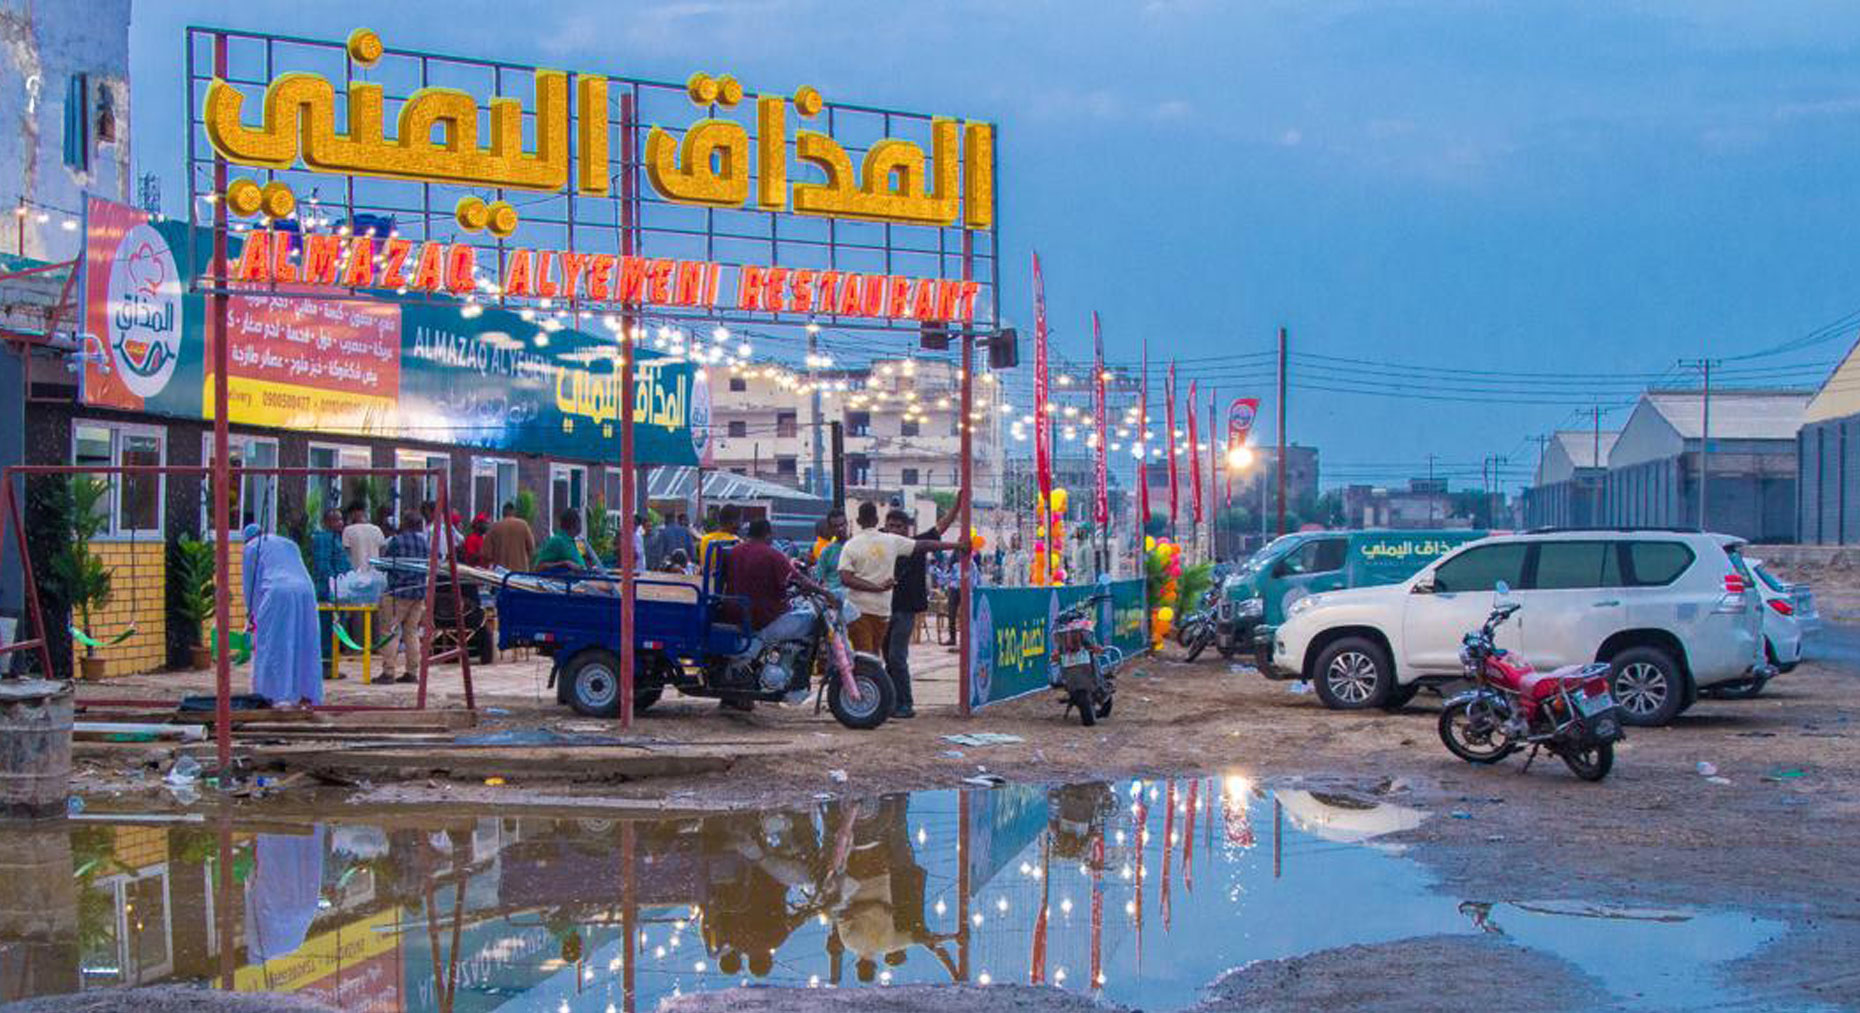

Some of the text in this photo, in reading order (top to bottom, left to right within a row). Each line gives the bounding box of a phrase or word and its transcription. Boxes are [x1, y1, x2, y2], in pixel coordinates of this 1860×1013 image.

[204, 27, 994, 239] المذاق اليمني
[240, 228, 982, 324] ALMAZAQ ALYEMENI RESTAURANT
[115, 293, 174, 333] المذاق
[413, 325, 488, 377] ALMAZAQ
[1361, 540, 1413, 560] اليمني
